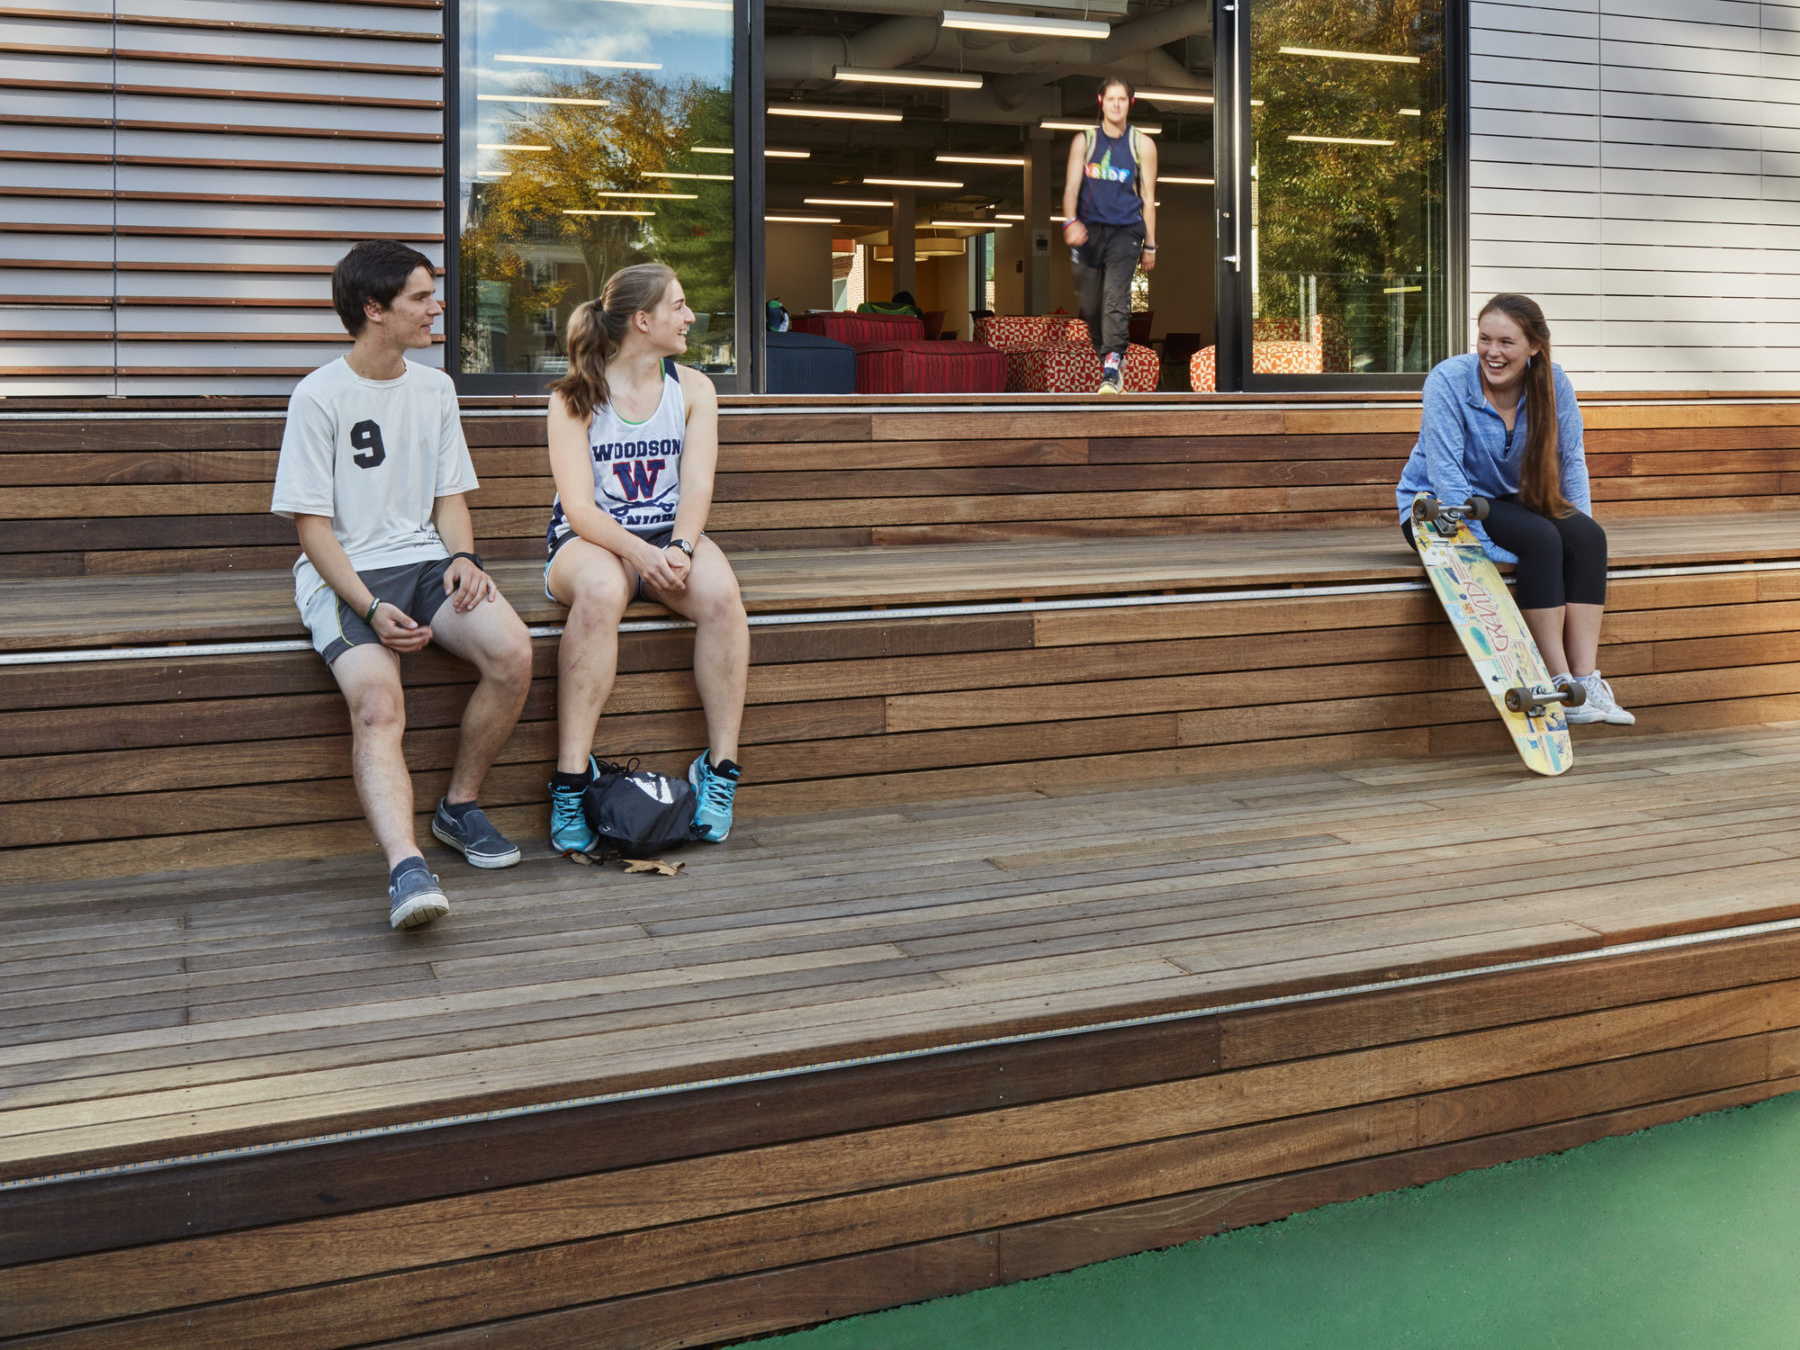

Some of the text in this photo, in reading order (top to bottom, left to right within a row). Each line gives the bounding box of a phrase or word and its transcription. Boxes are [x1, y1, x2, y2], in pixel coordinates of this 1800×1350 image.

[350, 419, 386, 469] 9
[592, 439, 681, 462] WOODSON
[613, 458, 665, 501] W
